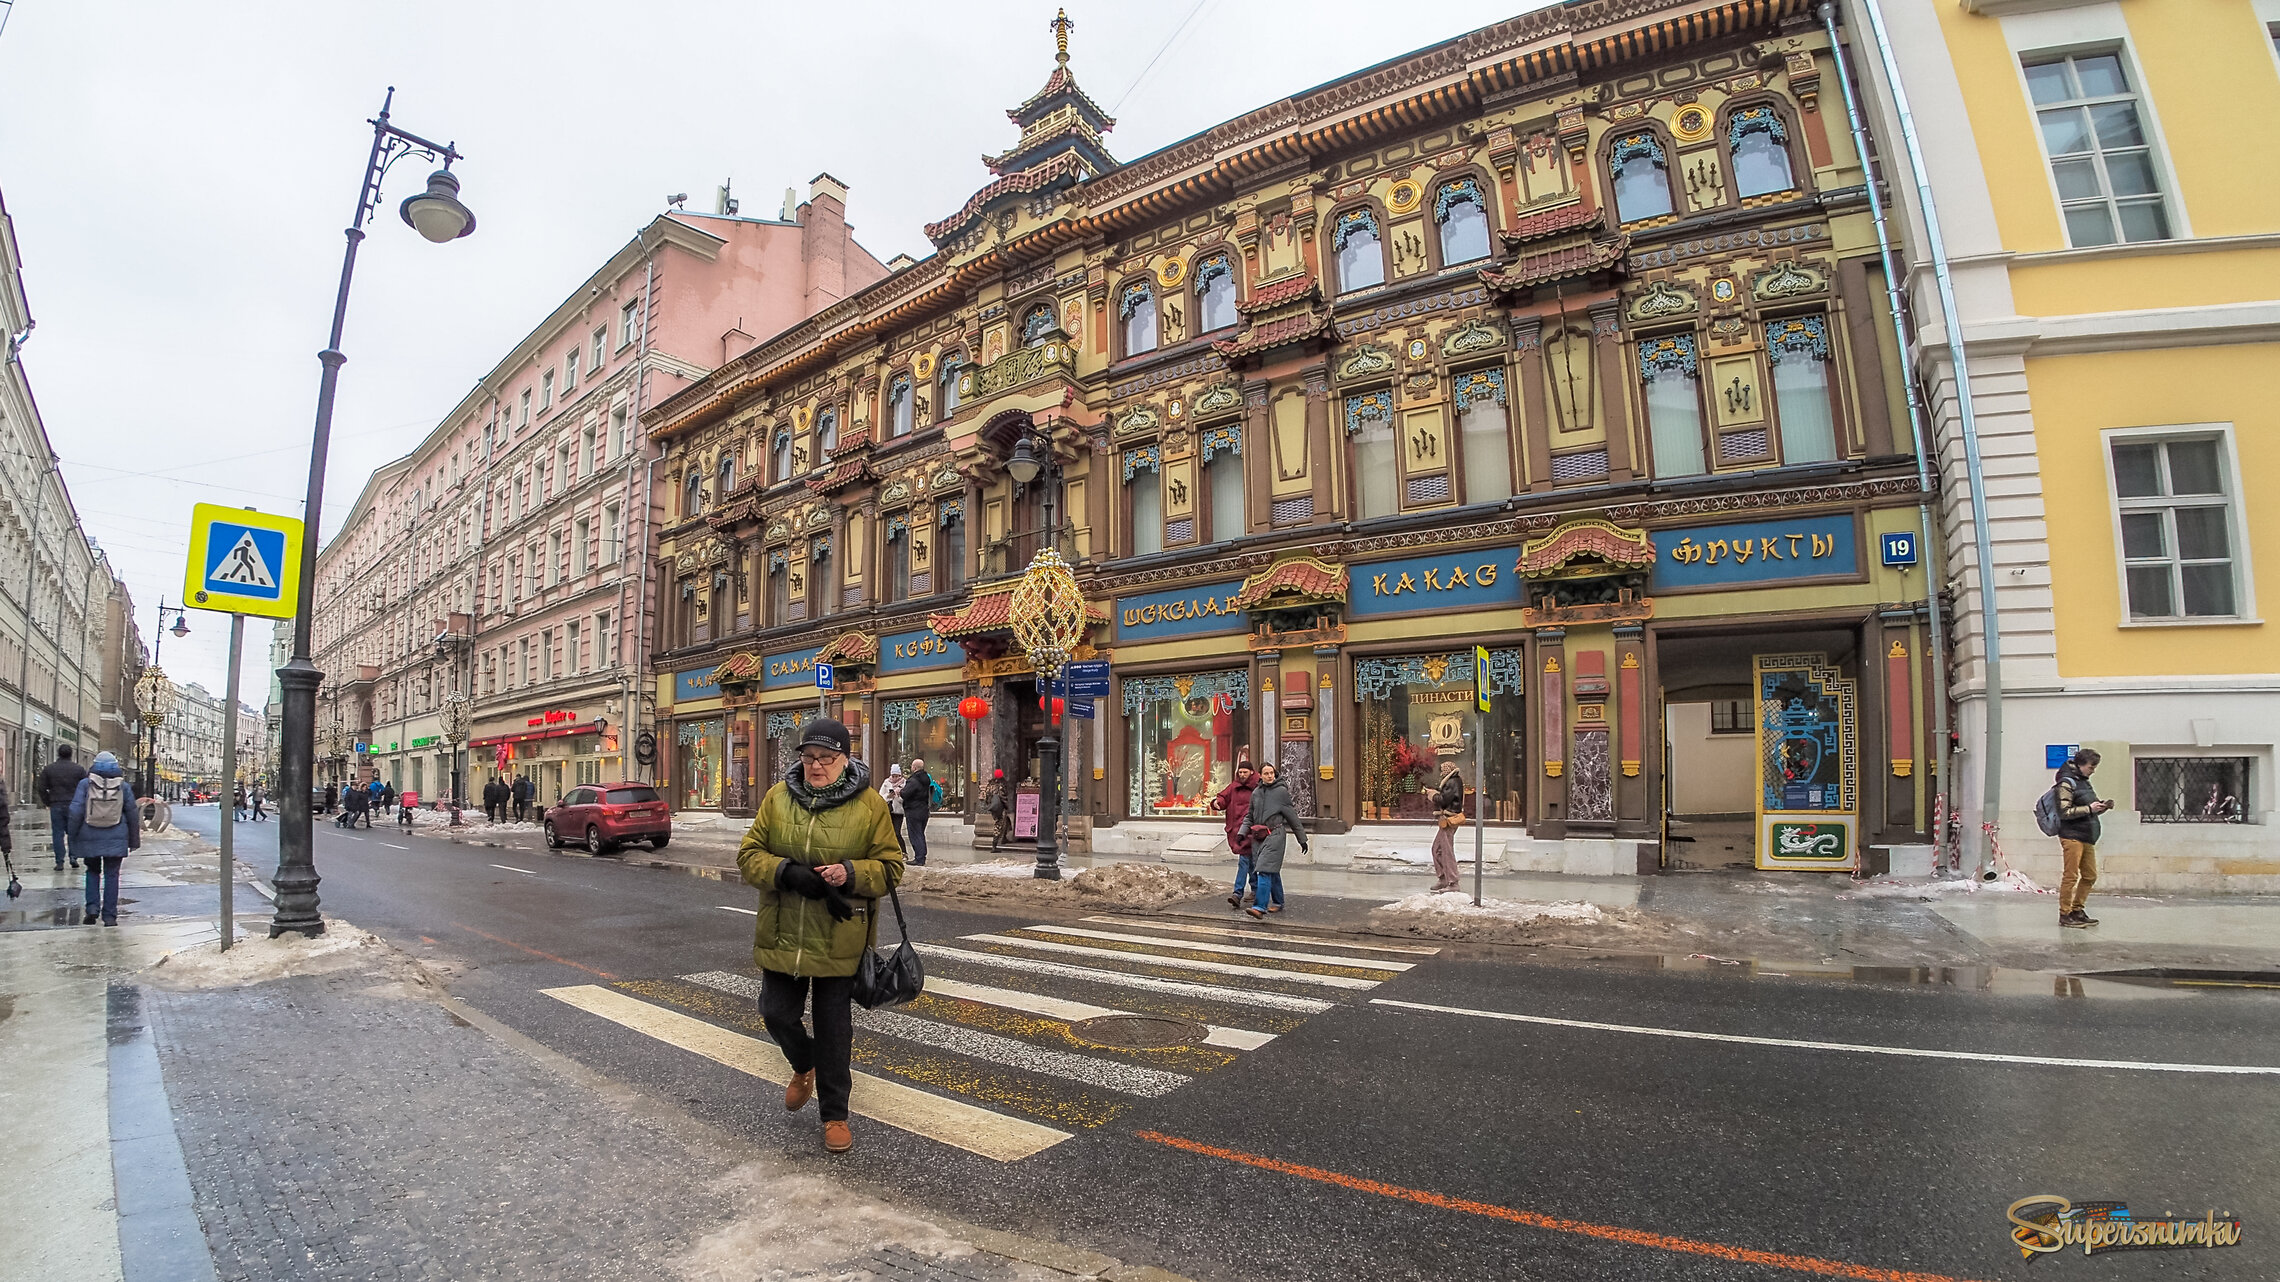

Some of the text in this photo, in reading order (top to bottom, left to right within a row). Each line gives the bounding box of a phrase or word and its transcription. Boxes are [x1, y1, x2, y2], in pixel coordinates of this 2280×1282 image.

[1672, 533, 1834, 565] ФРУКТЫ
[1888, 539, 1909, 556] 19
[1373, 564, 1498, 597] КАКАО
[895, 635, 948, 659] КОФЕ
